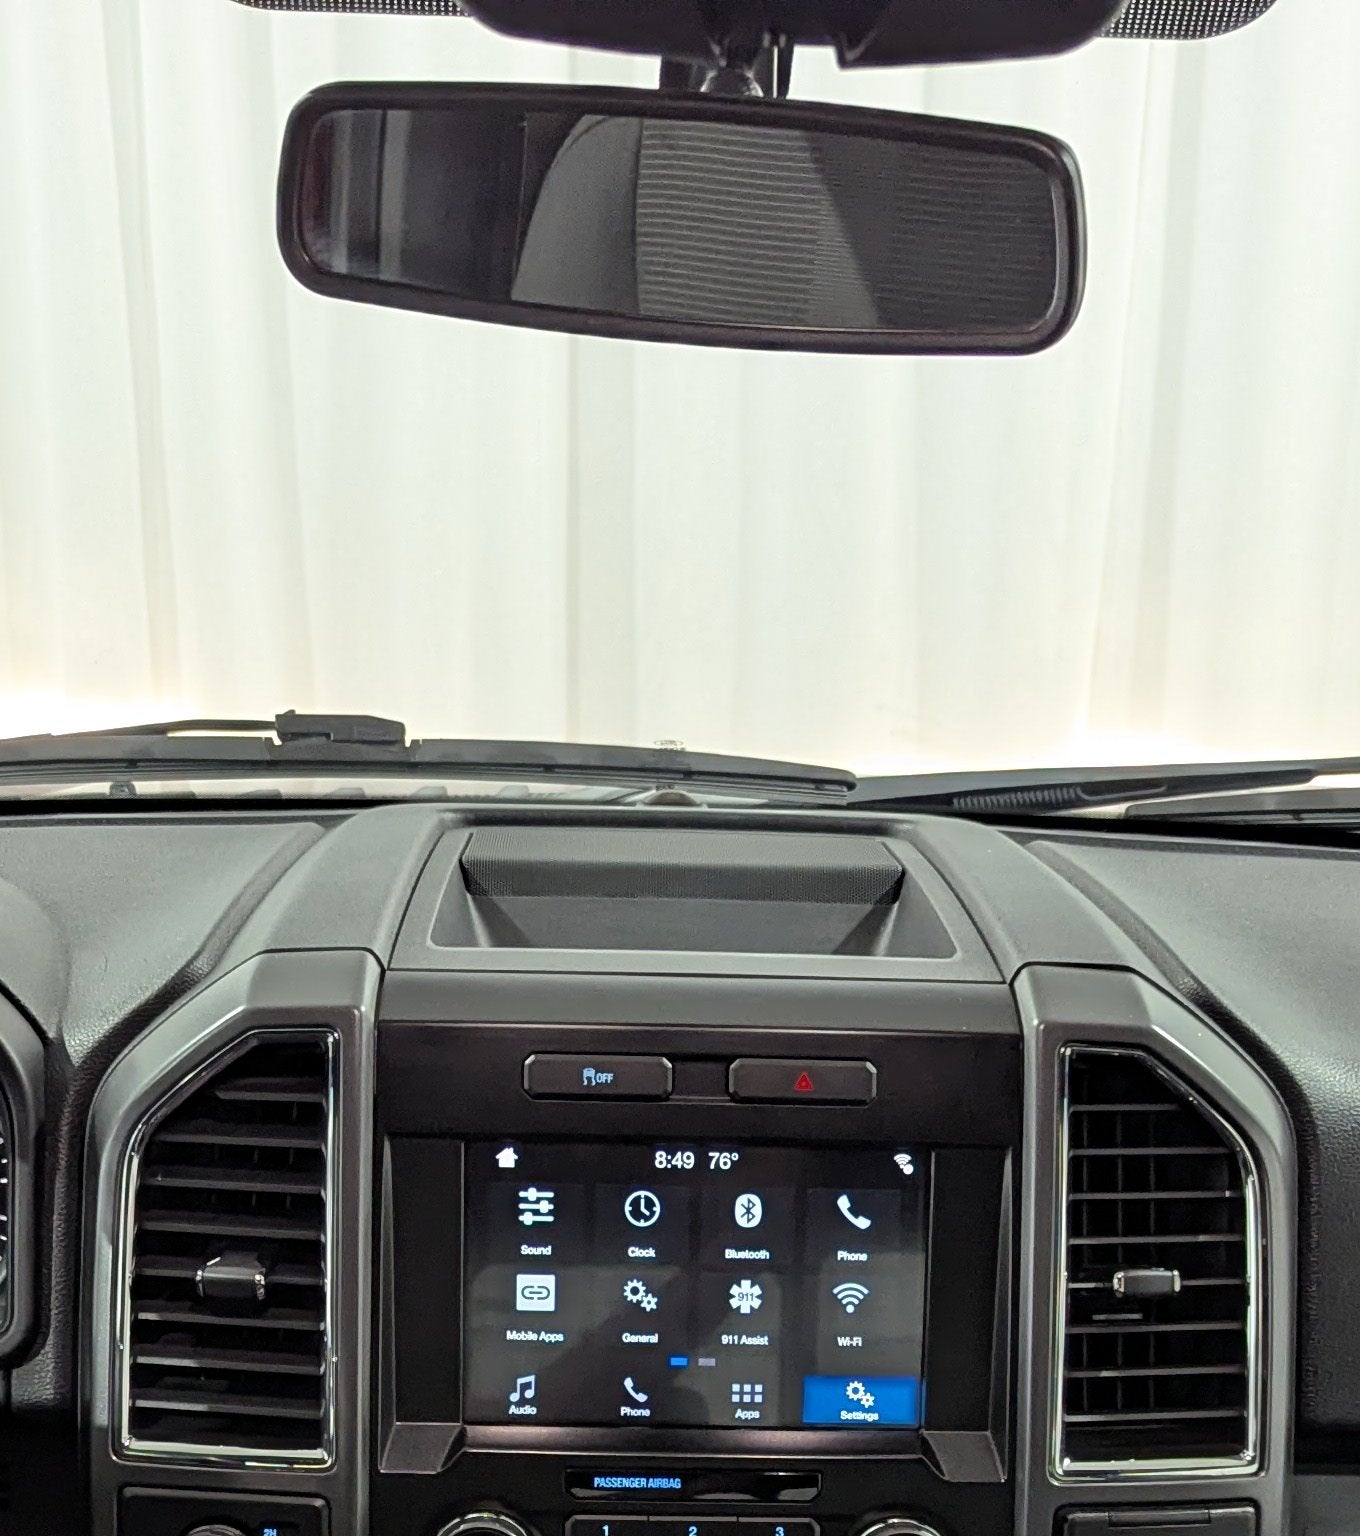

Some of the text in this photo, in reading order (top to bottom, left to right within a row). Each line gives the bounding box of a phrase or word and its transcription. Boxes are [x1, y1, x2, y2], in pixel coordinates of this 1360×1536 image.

[596, 1072, 614, 1084] OFF
[655, 1150, 739, 1170] 8:49 76°
[520, 1244, 552, 1256] Sound
[627, 1246, 656, 1258] Clock
[725, 1248, 769, 1260] Bluetooth
[837, 1250, 868, 1261] Phone
[737, 1292, 755, 1302] 911
[506, 1330, 564, 1343] Mobile Apps
[622, 1332, 658, 1343] General
[721, 1334, 769, 1346] 911 Assist
[837, 1336, 862, 1347] Wi-Fi
[508, 1404, 537, 1415] Audio
[620, 1406, 651, 1417] Phone
[735, 1408, 760, 1420] Apps
[840, 1410, 879, 1422] Settings
[594, 1477, 682, 1489] PASSENGER AIRBAG
[602, 1525, 609, 1536] 1
